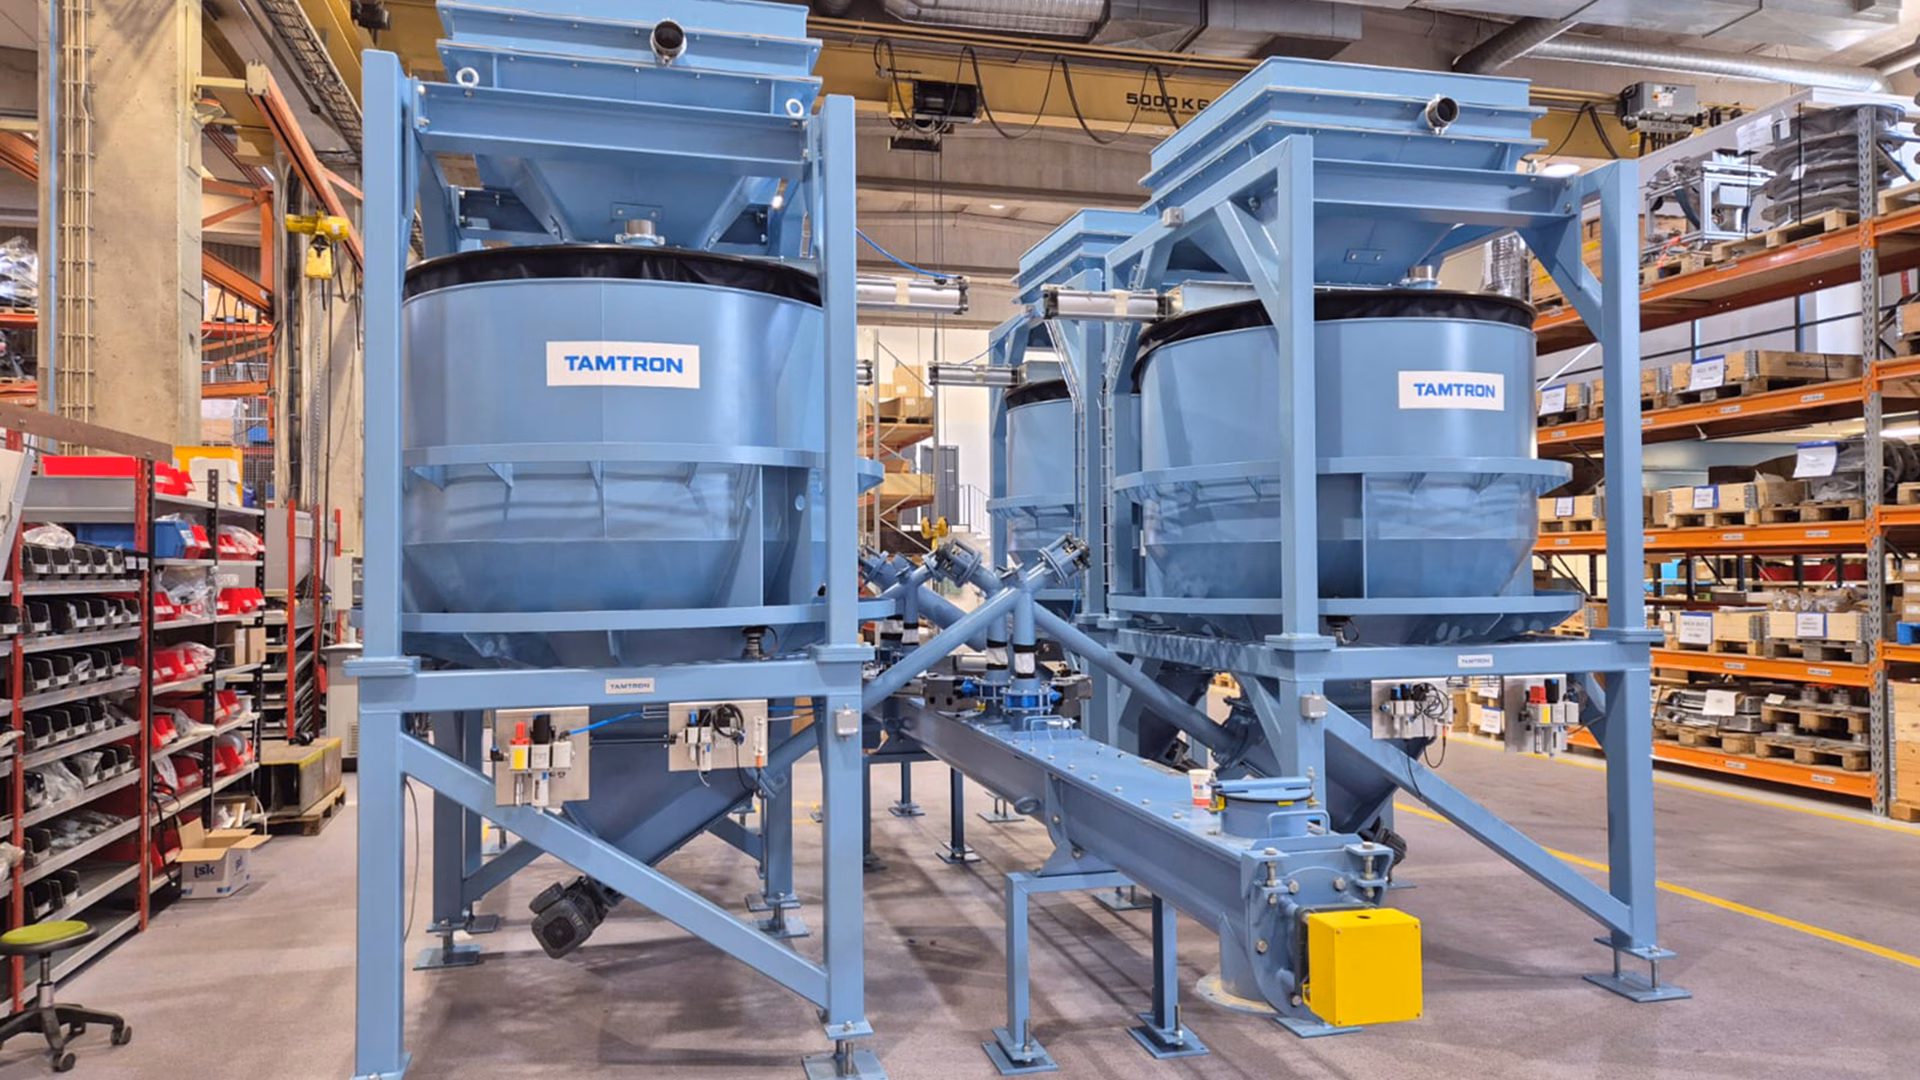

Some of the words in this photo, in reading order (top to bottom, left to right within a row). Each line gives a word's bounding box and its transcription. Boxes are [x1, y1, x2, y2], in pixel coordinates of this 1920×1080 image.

[1126, 92, 1178, 108] 5000
[564, 355, 683, 373] TAMTRON
[1413, 383, 1495, 398] TAMTRON
